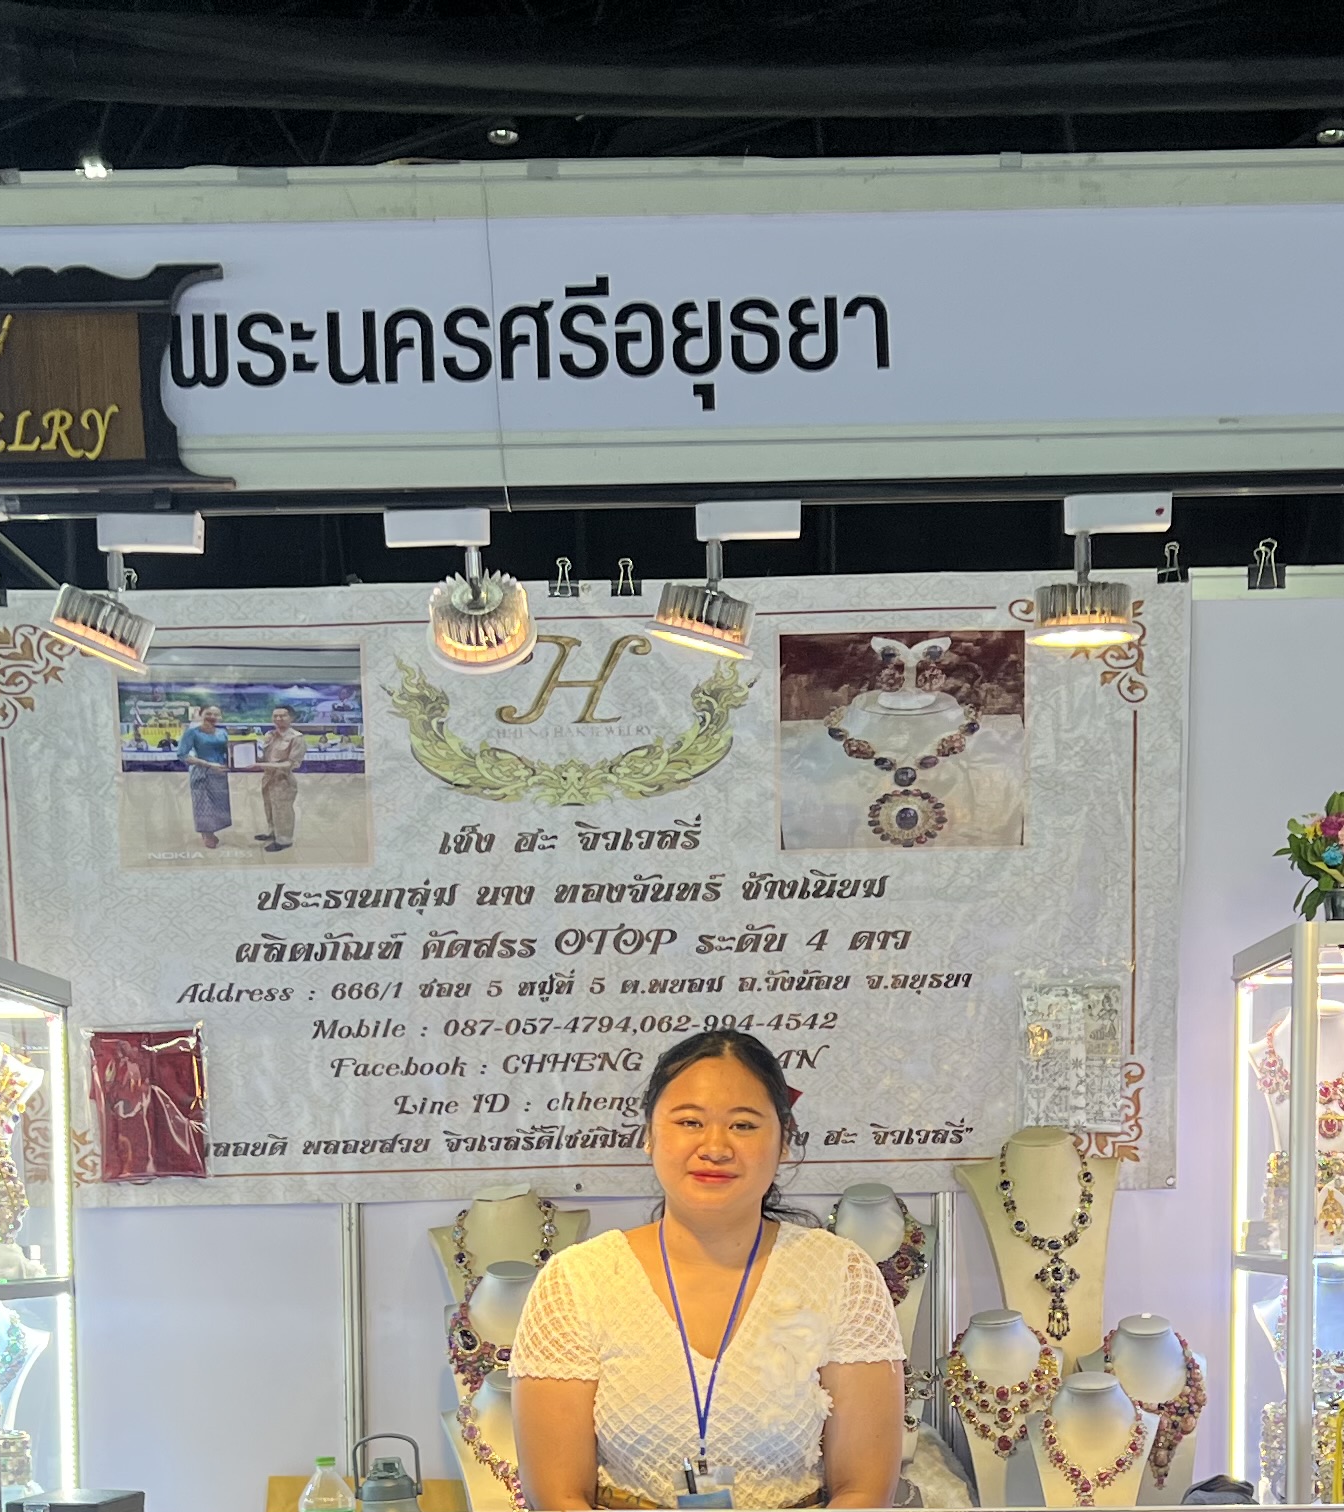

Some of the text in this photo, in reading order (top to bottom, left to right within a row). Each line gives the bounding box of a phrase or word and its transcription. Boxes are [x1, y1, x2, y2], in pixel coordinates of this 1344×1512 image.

[168, 272, 893, 412] พระนครศรีอยุธยา
[148, 850, 205, 860] NOKIA
[476, 885, 536, 906] นาง
[554, 922, 678, 956] OTOP
[695, 924, 788, 955] ระดับ
[805, 928, 829, 952] 4
[176, 982, 295, 1004] Address
[331, 981, 403, 1001] 666/1
[486, 980, 503, 998] 5
[589, 977, 606, 995] 5
[312, 1018, 406, 1039] Mobile
[330, 1056, 467, 1078] Facebook
[502, 1047, 644, 1074] CHHENG
[394, 1095, 459, 1116] Line
[472, 1093, 510, 1113] ID
